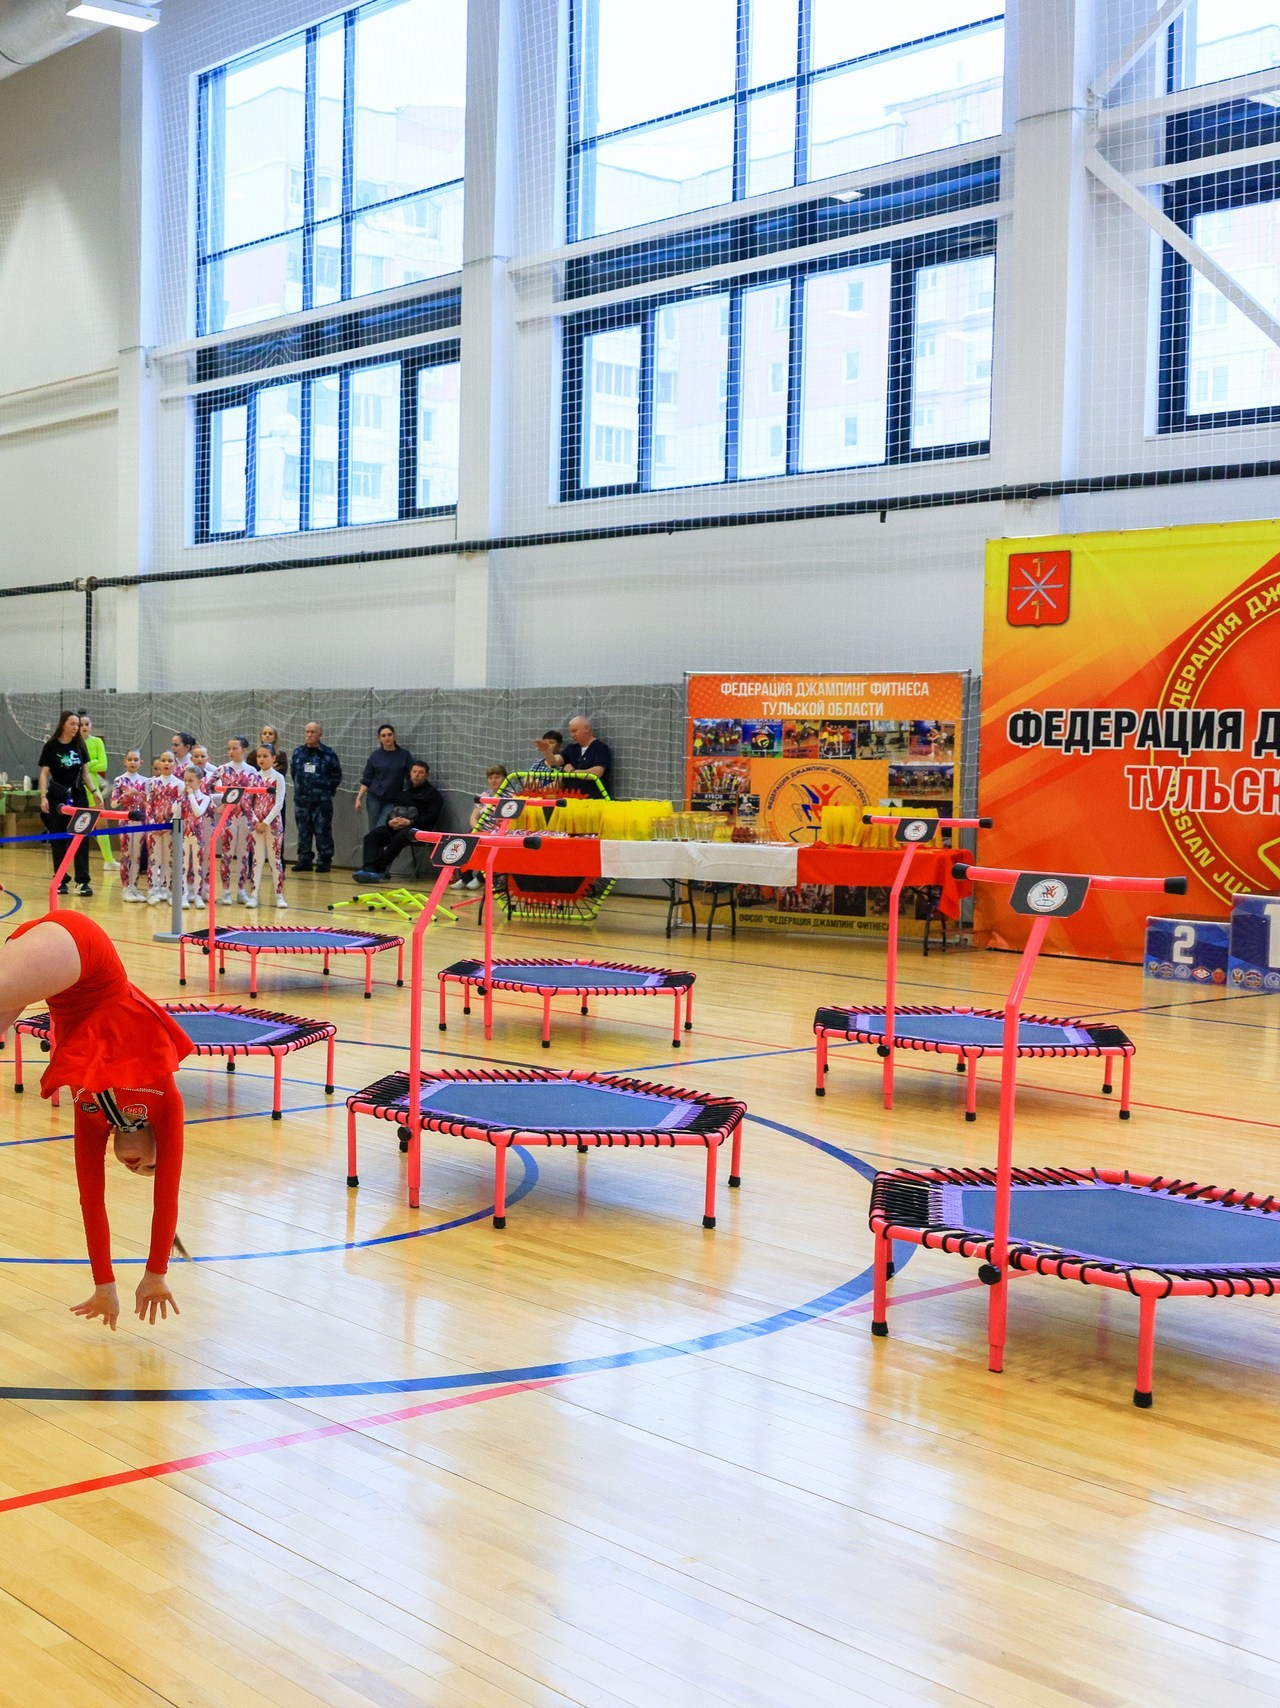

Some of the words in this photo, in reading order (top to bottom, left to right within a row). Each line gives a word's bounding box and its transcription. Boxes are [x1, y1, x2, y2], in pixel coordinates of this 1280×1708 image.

[1169, 611, 1243, 711] ДЕРАЦИЯ
[721, 682, 793, 698] ФЕДЕРАЦИЯ
[795, 682, 867, 699] ДЖАМПИНГ
[870, 681, 929, 697] ФИТНЕСА
[762, 700, 825, 717] ТУЛЬСКОЙ
[827, 701, 884, 717] ОБЛАСТИ
[1007, 708, 1243, 756] ФЕДЕРАЦИЯ
[767, 776, 791, 810] ФЕДЕРАЦИЯ
[831, 768, 858, 789] ФИТНЕСА
[812, 919, 855, 929] ДЖАМПИНГ
[1172, 925, 1196, 965] 2
